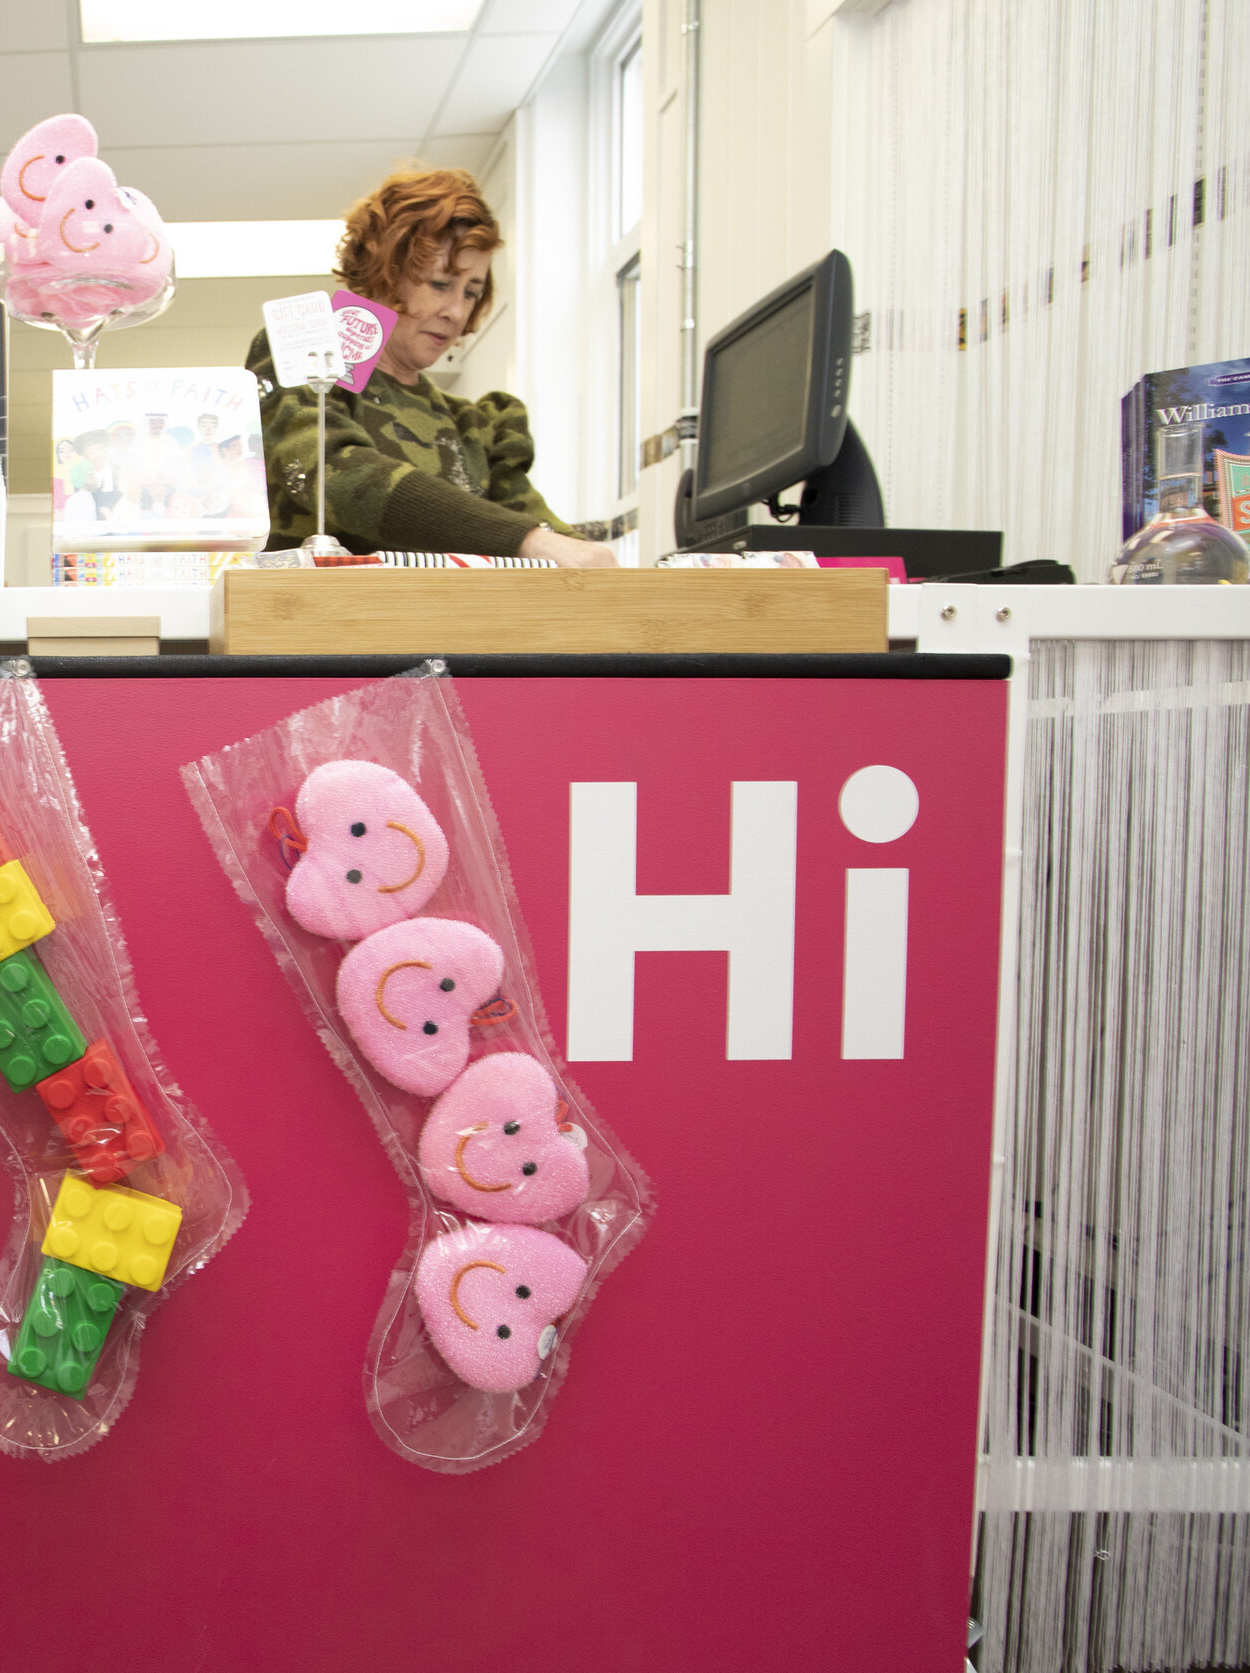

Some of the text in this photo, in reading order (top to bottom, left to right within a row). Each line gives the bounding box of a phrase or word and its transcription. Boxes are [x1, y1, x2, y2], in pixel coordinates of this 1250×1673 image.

[339, 314, 379, 335] FUTURE
[72, 380, 138, 413] HATS
[170, 379, 245, 412] FAITH
[566, 764, 920, 1062] Hi
